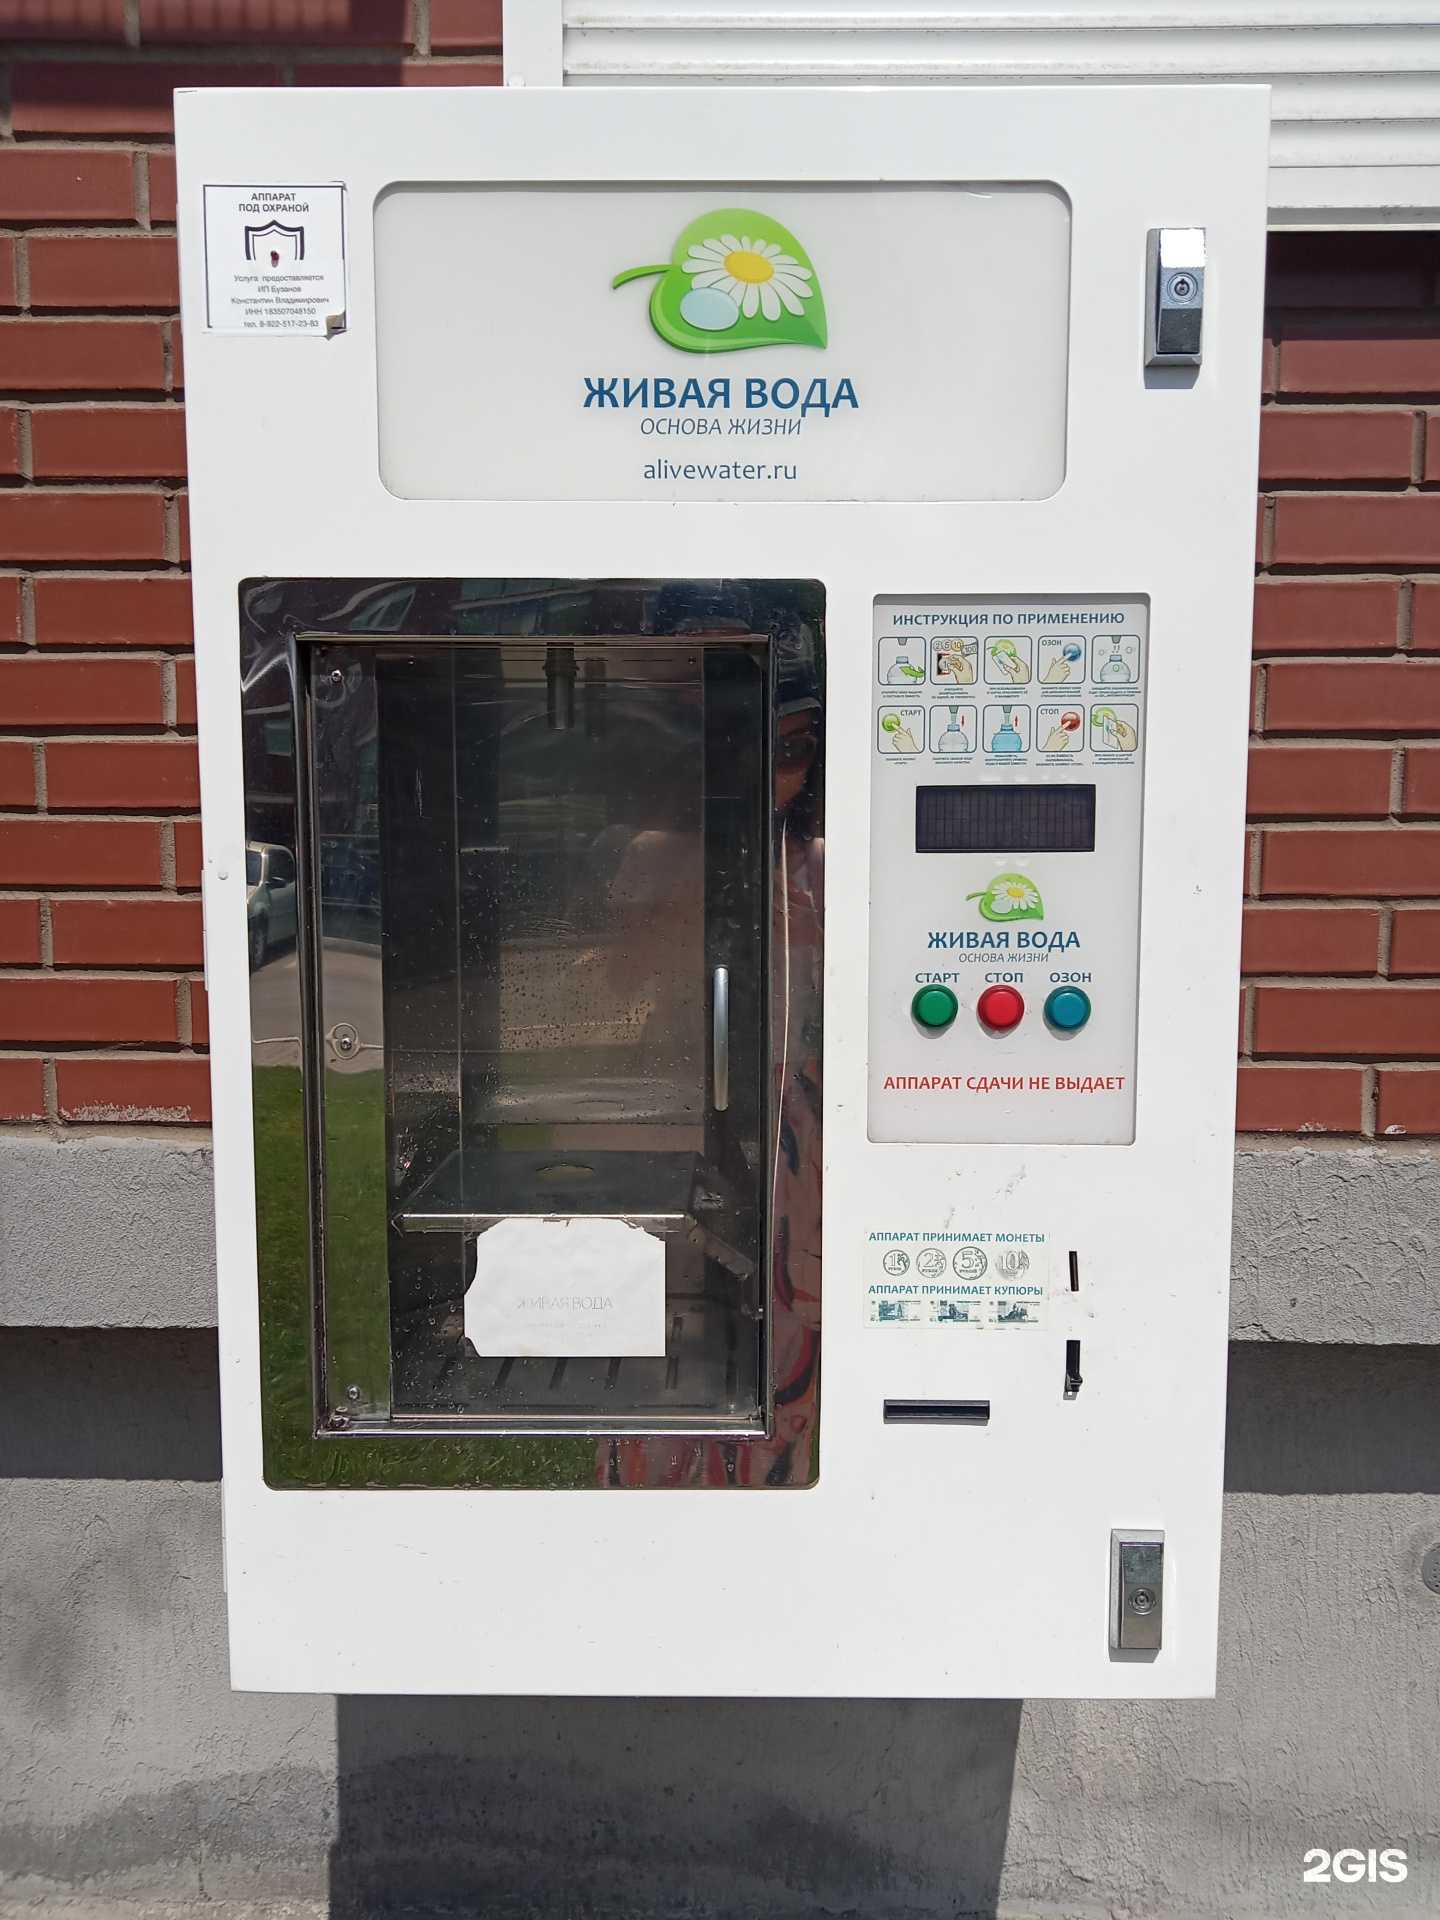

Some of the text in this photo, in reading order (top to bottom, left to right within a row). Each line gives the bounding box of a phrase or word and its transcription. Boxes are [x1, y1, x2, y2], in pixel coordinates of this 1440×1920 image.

[251, 193, 296, 201] АППАРАТ
[239, 202, 309, 213] ПОД ОХРАНОЙ
[234, 275, 324, 283] Услуга предоставляется
[231, 297, 329, 305] Константин Владимирович
[583, 377, 860, 417] ЖИВАЯ ВОДА
[640, 418, 802, 435] ОСНОВА ЖИЗНИ
[643, 459, 797, 480] alivewater.ru
[893, 612, 1125, 628] ИНСТРУКЦИЯ ПО ПРИМЕНЕНИЮ
[1041, 639, 1062, 647] ОЗОН
[900, 709, 921, 717] СТАРТ
[1040, 708, 1060, 716] СТОП
[928, 931, 1080, 952] ЖИВАЯ ВОДА
[958, 953, 1049, 963] ОСНОВА ЖИЗНИ
[915, 972, 960, 983] СТАРТ
[984, 972, 1024, 983] СТОП
[1049, 972, 1092, 983] ОЗОН
[884, 1077, 1125, 1092] АППАРАТ СДАЧИ НЕ ВЫДАЕТ
[869, 1232, 1045, 1243] АППАРАТ ПРИНИМАЕТ МОНЕТЫ
[961, 1250, 974, 1268] 5
[868, 1285, 1043, 1296] АППАРАТ ПРИНИМАЕТ КУПЮРЫ
